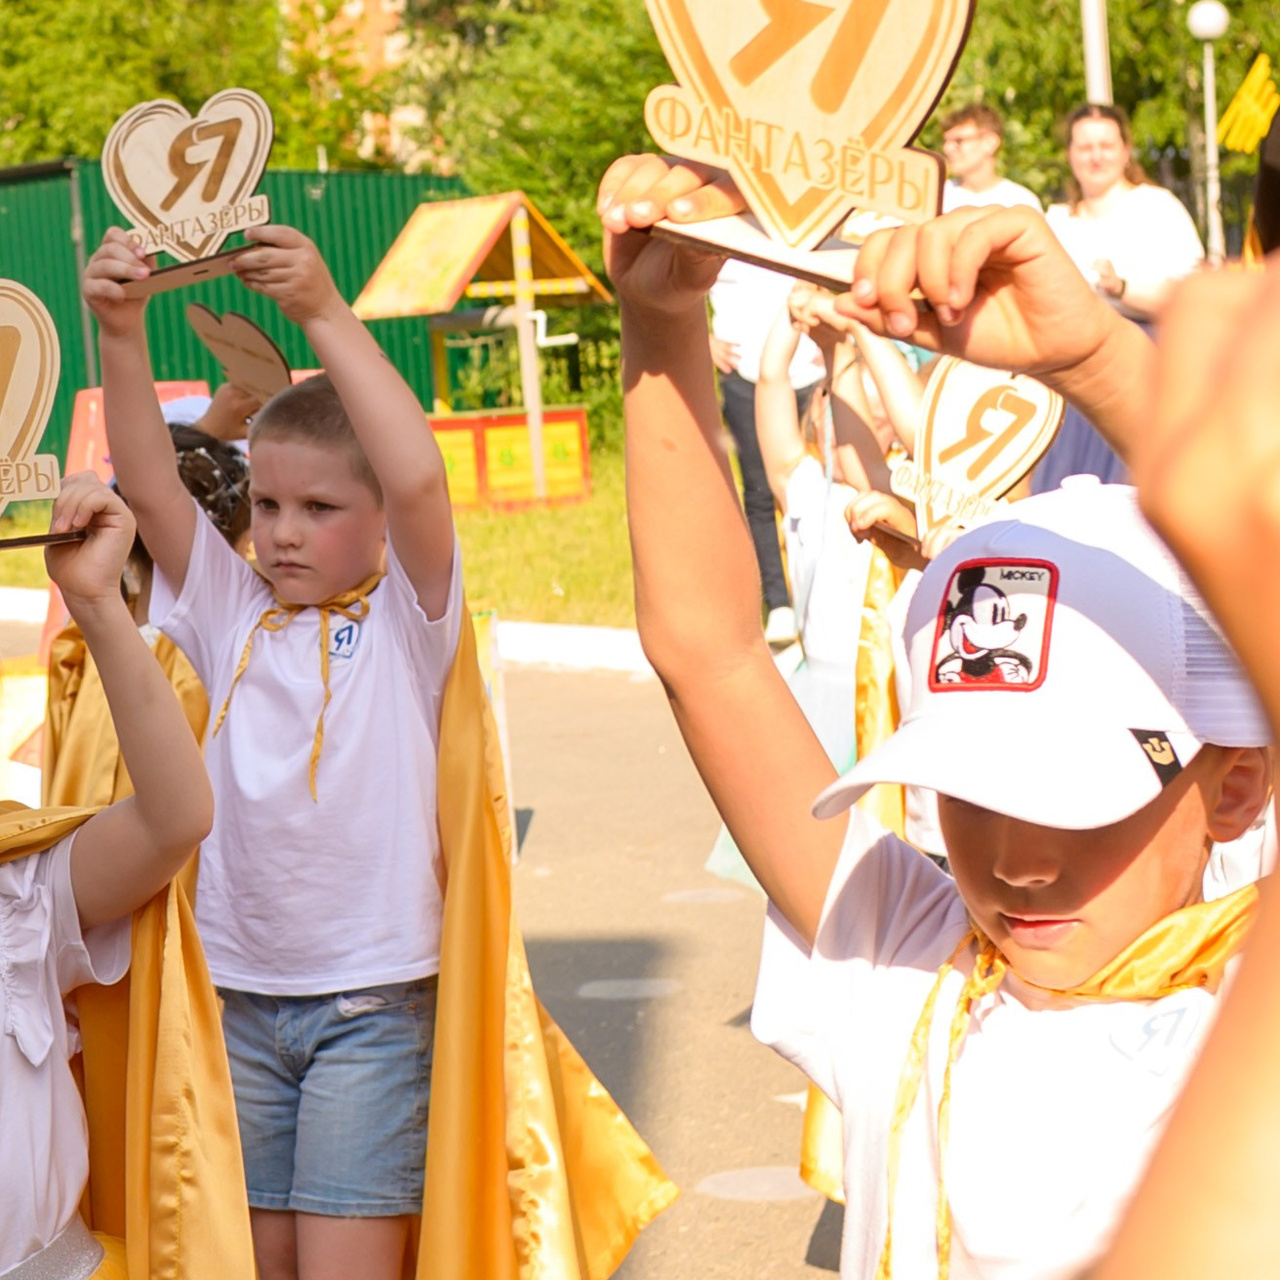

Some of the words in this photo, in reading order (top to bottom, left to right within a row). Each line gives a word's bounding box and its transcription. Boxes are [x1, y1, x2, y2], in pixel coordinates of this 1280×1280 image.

[160, 117, 242, 212] Я
[653, 96, 931, 213] ФАНТАЗЁРЫ
[938, 385, 1038, 482] Я
[1000, 568, 1045, 581] MICKEY
[334, 624, 354, 651] Я
